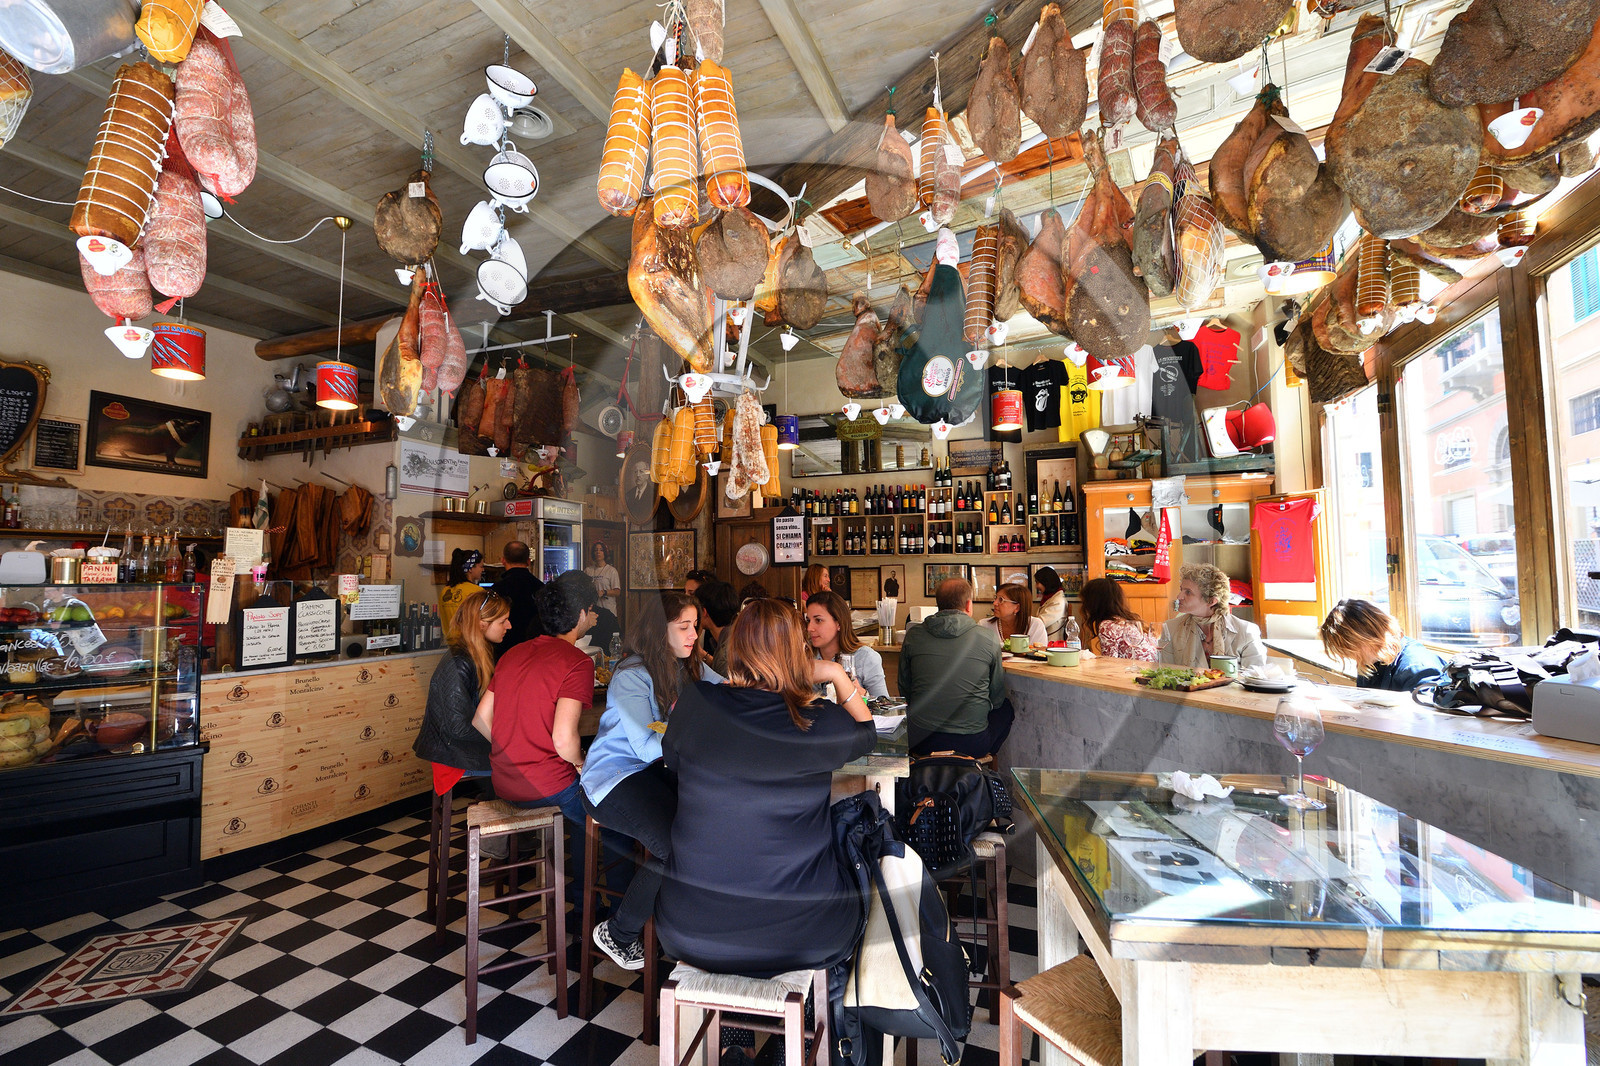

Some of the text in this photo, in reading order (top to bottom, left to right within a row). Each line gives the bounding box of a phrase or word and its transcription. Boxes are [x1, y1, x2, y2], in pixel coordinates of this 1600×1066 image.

[295, 676, 320, 684] Brunello
[290, 686, 324, 695] Montalcino
[320, 762, 344, 772] Brunello
[315, 771, 348, 782] Montalcino
